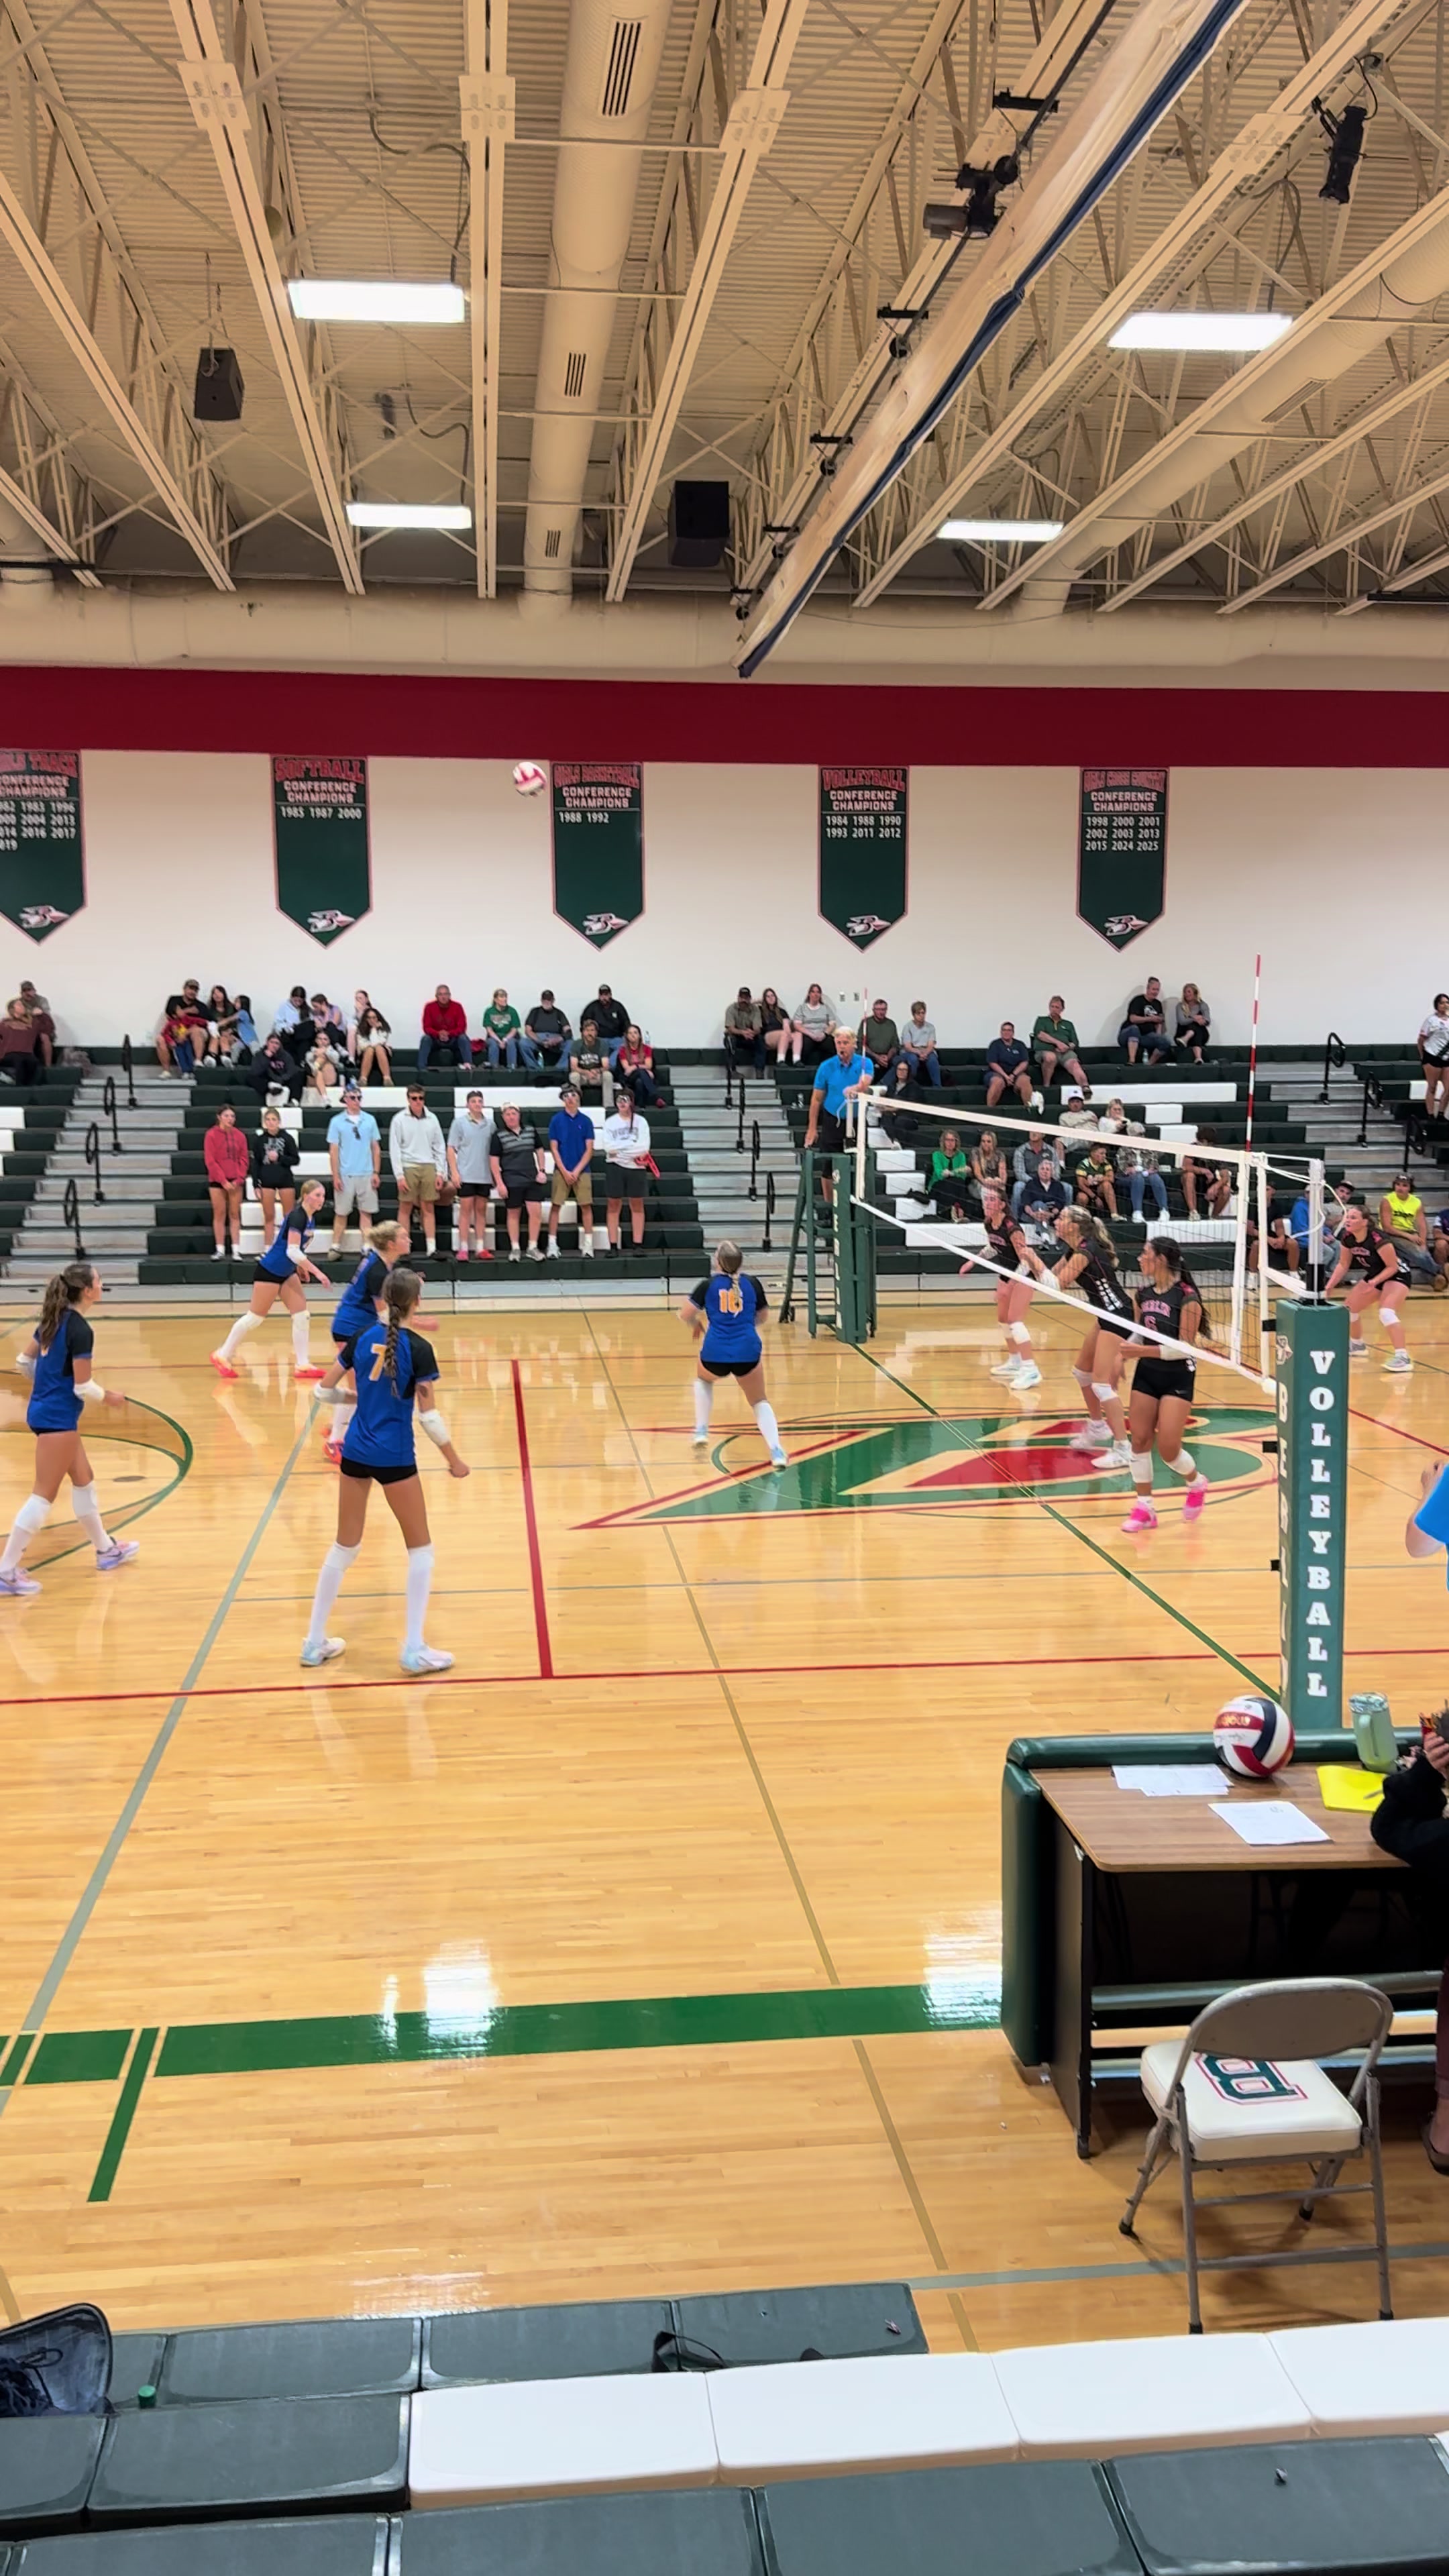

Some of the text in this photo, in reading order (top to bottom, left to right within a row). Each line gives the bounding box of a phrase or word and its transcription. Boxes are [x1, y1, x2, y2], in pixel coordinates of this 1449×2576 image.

[275, 759, 365, 784] SOFTBALL
[0, 775, 70, 788] ONFERENCE
[822, 769, 906, 792] VOLLEYBALL
[283, 781, 356, 793] CONFERENCE
[562, 786, 632, 798] CONFERENCE
[287, 792, 354, 804] CHAMPIONS
[829, 790, 898, 800] CONFERENCE
[1090, 791, 1158, 802] CONFERENCE
[565, 798, 629, 808] CHAMPIONS
[833, 801, 895, 811] CHAMPIONS
[1093, 802, 1155, 812] CHAMPIONS
[337, 807, 362, 819] 2000
[559, 811, 609, 824] 1988 1992
[826, 815, 902, 826] 1984 1988 1990
[1086, 816, 1160, 826] 1998 2000 2001
[826, 827, 902, 838] 1993 2011 2012
[1085, 828, 1160, 839] 2002 2003 2013
[1085, 841, 1159, 851] 2015 2024 2025
[1306, 1350, 1336, 1698] VOLLEYBALL
